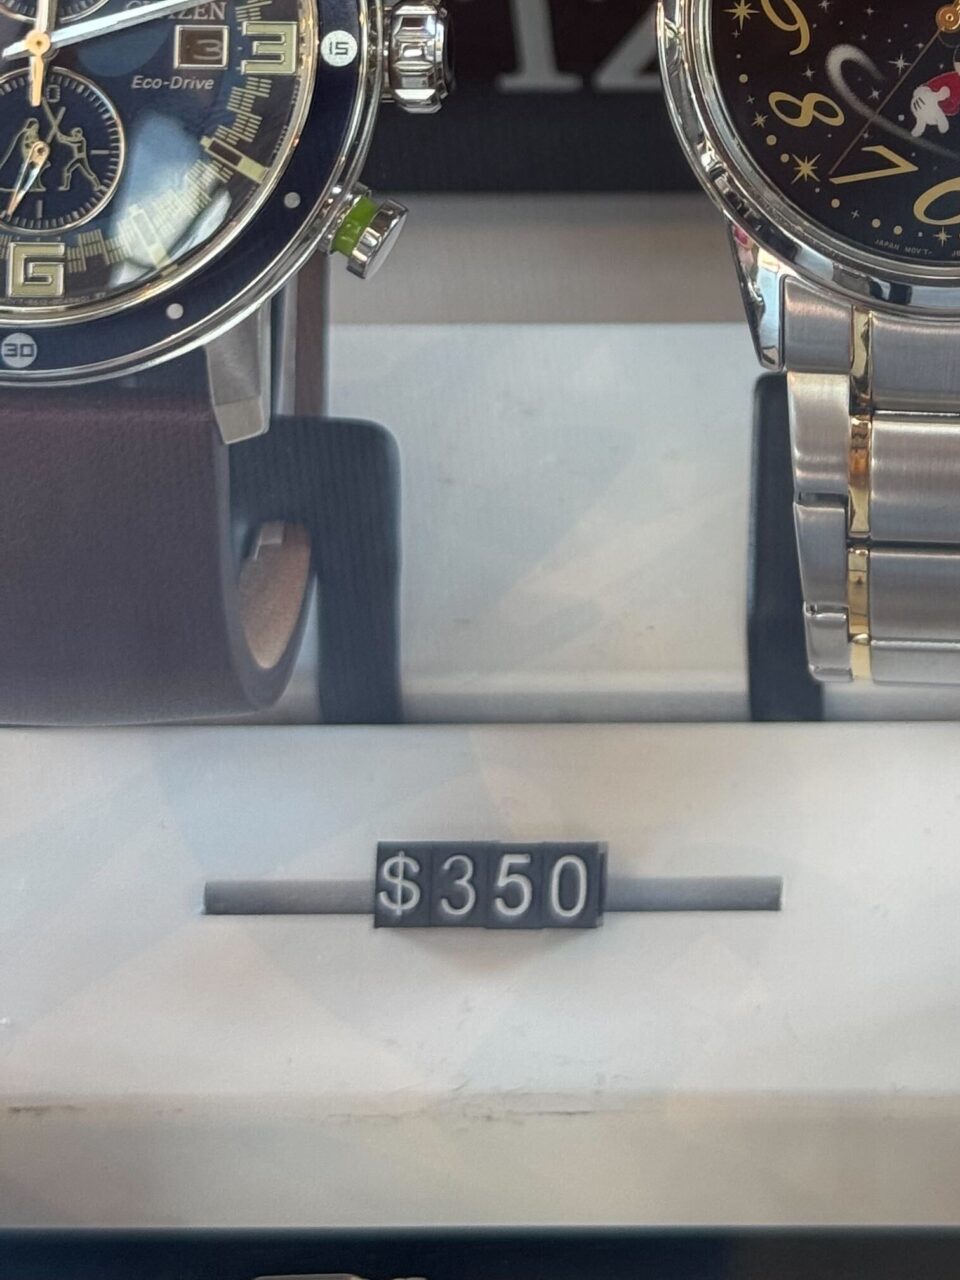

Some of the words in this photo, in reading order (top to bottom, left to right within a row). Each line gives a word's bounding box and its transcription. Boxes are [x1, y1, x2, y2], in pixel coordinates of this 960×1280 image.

[193, 39, 222, 60] 3
[241, 20, 297, 74] 3
[329, 41, 348, 55] 15
[131, 76, 214, 90] Eco-Drive
[768, 91, 845, 127] 8
[829, 145, 919, 184] 7
[4, 343, 33, 357] 30
[378, 851, 587, 918] $350
